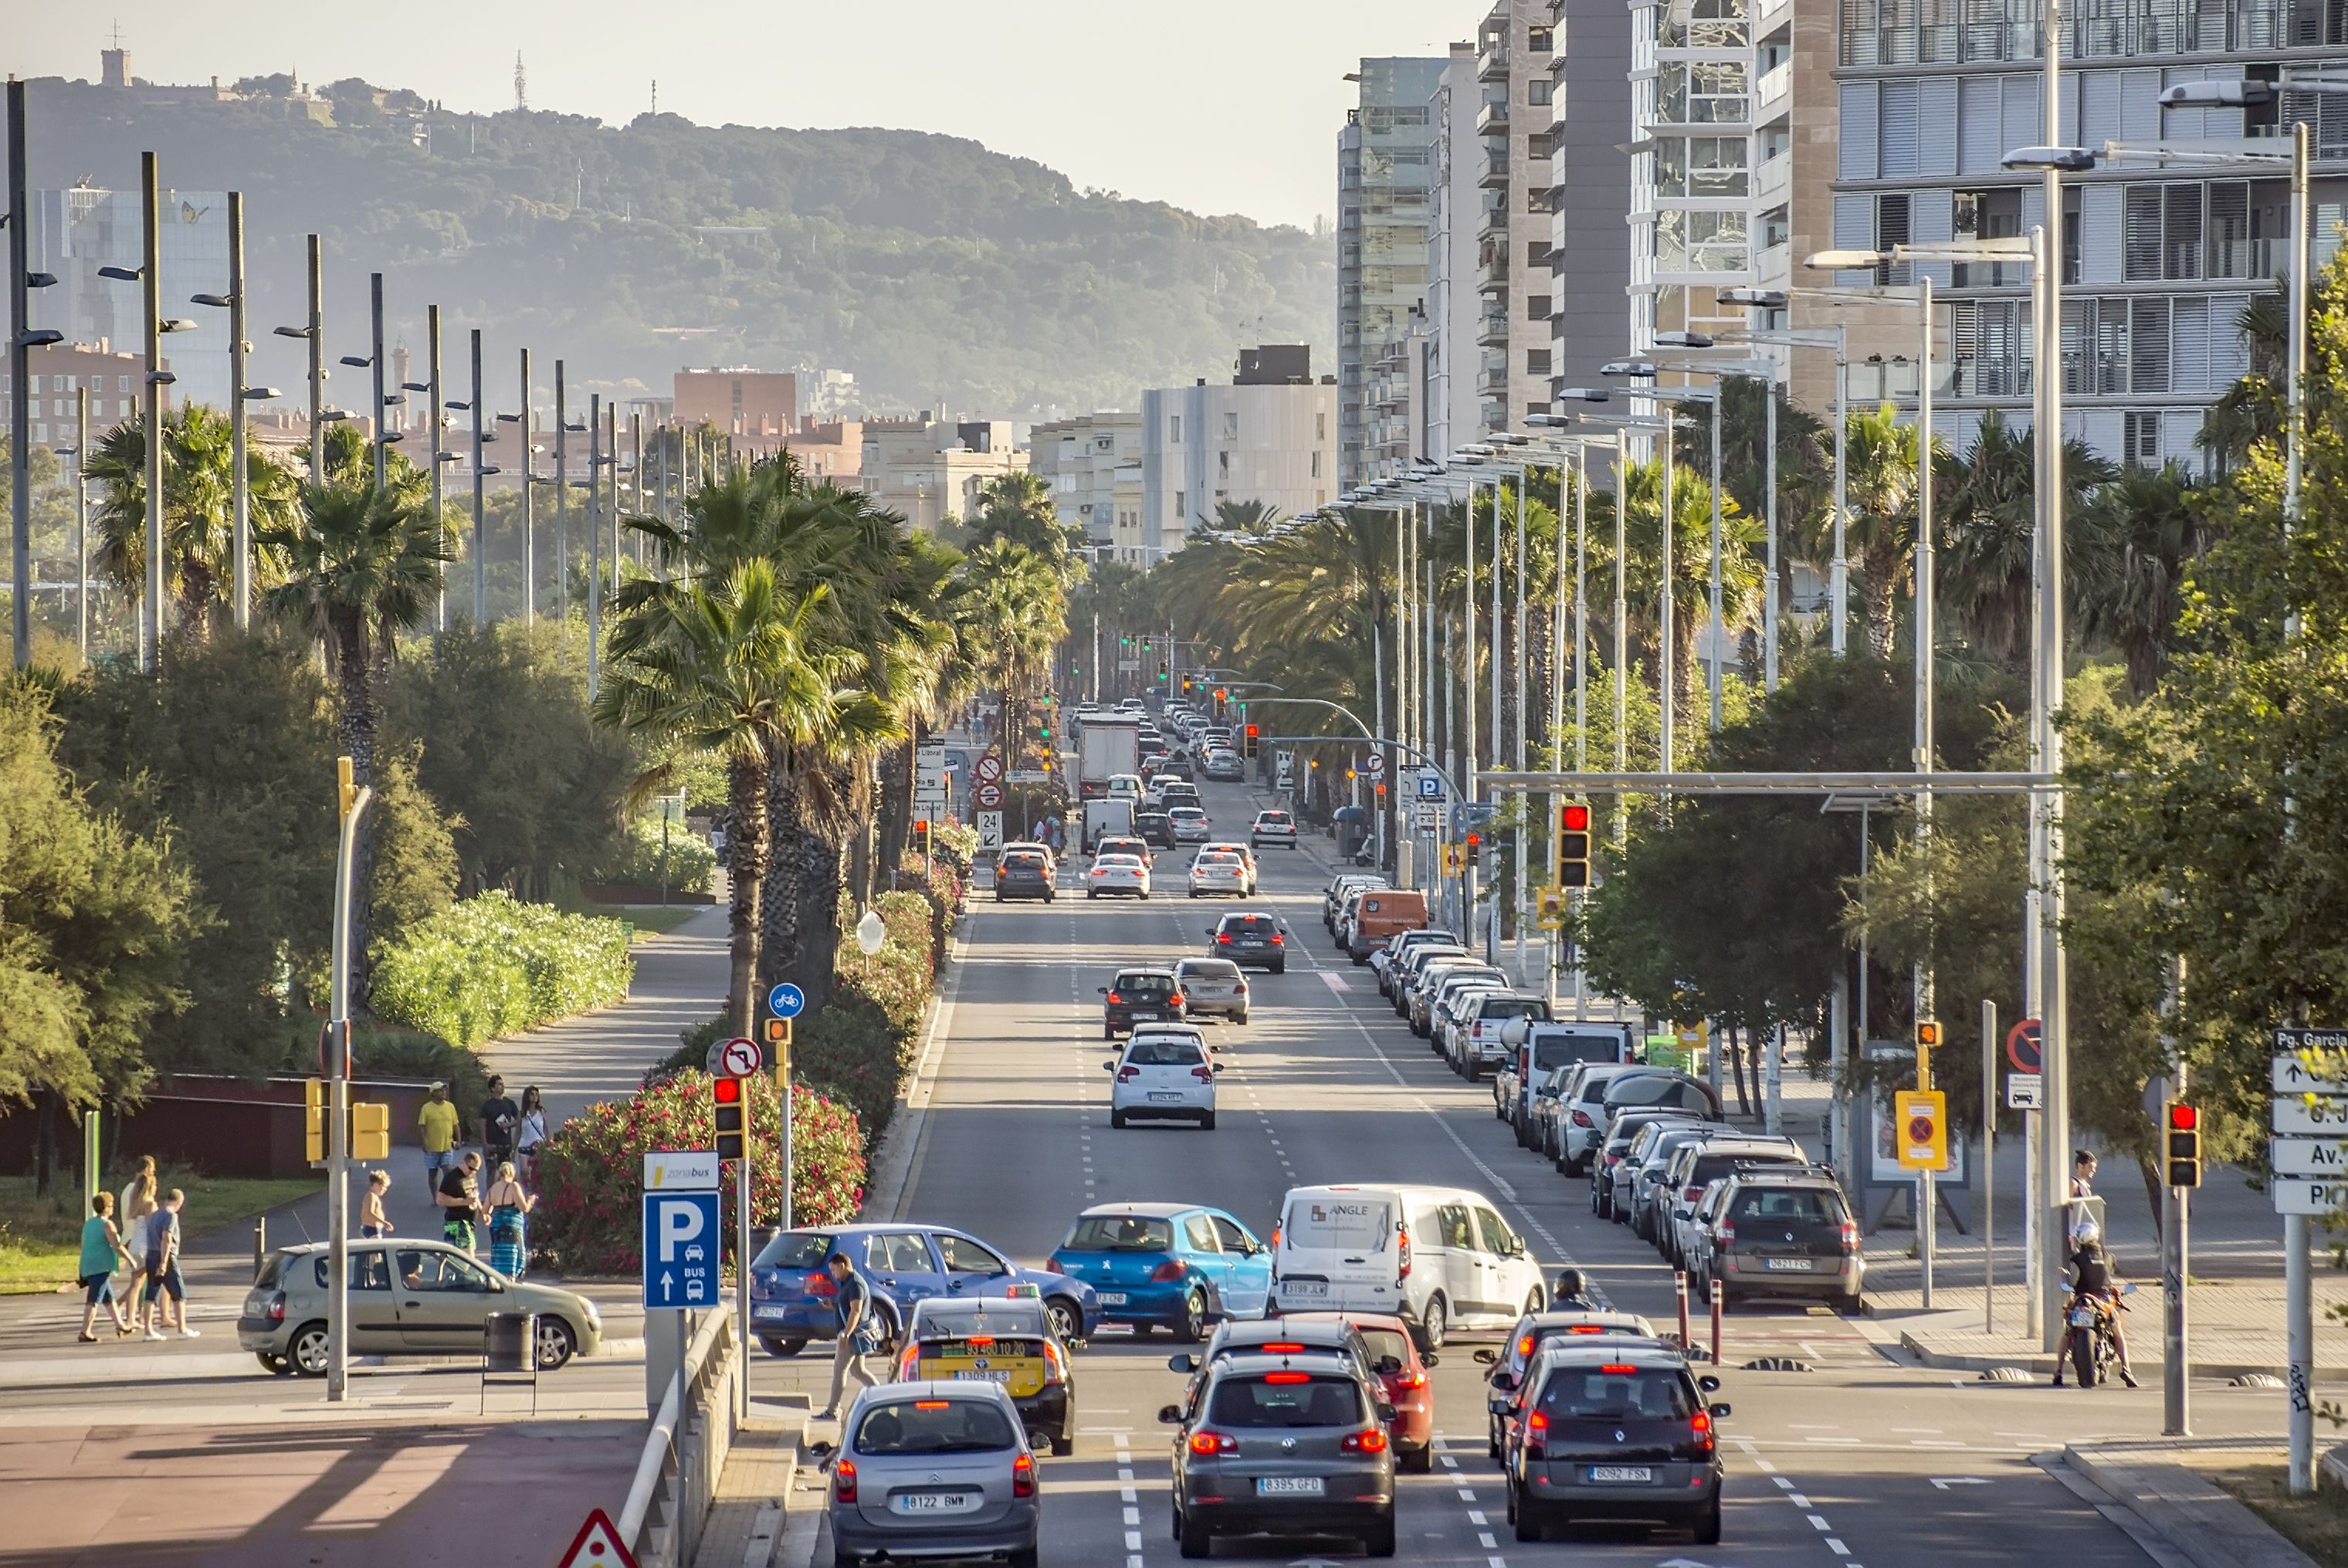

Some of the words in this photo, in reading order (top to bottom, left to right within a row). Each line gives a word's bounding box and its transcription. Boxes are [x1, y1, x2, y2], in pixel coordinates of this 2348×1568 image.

[1422, 780, 1436, 795] P
[984, 814, 997, 828] 24
[2278, 1032, 2299, 1048] Pg.
[2303, 1032, 2348, 1046] Garcia
[2311, 1144, 2343, 1164] Av.
[668, 1167, 710, 1179] zonabus
[2310, 1184, 2336, 1204] Pl.
[1330, 1205, 1368, 1216] ANGLE
[659, 1201, 704, 1262] P
[684, 1268, 706, 1278] BUS
[988, 1371, 1008, 1381] HLS
[1265, 1479, 1295, 1490] 8395
[910, 1497, 937, 1508] 8122
[944, 1495, 964, 1507] BMW
